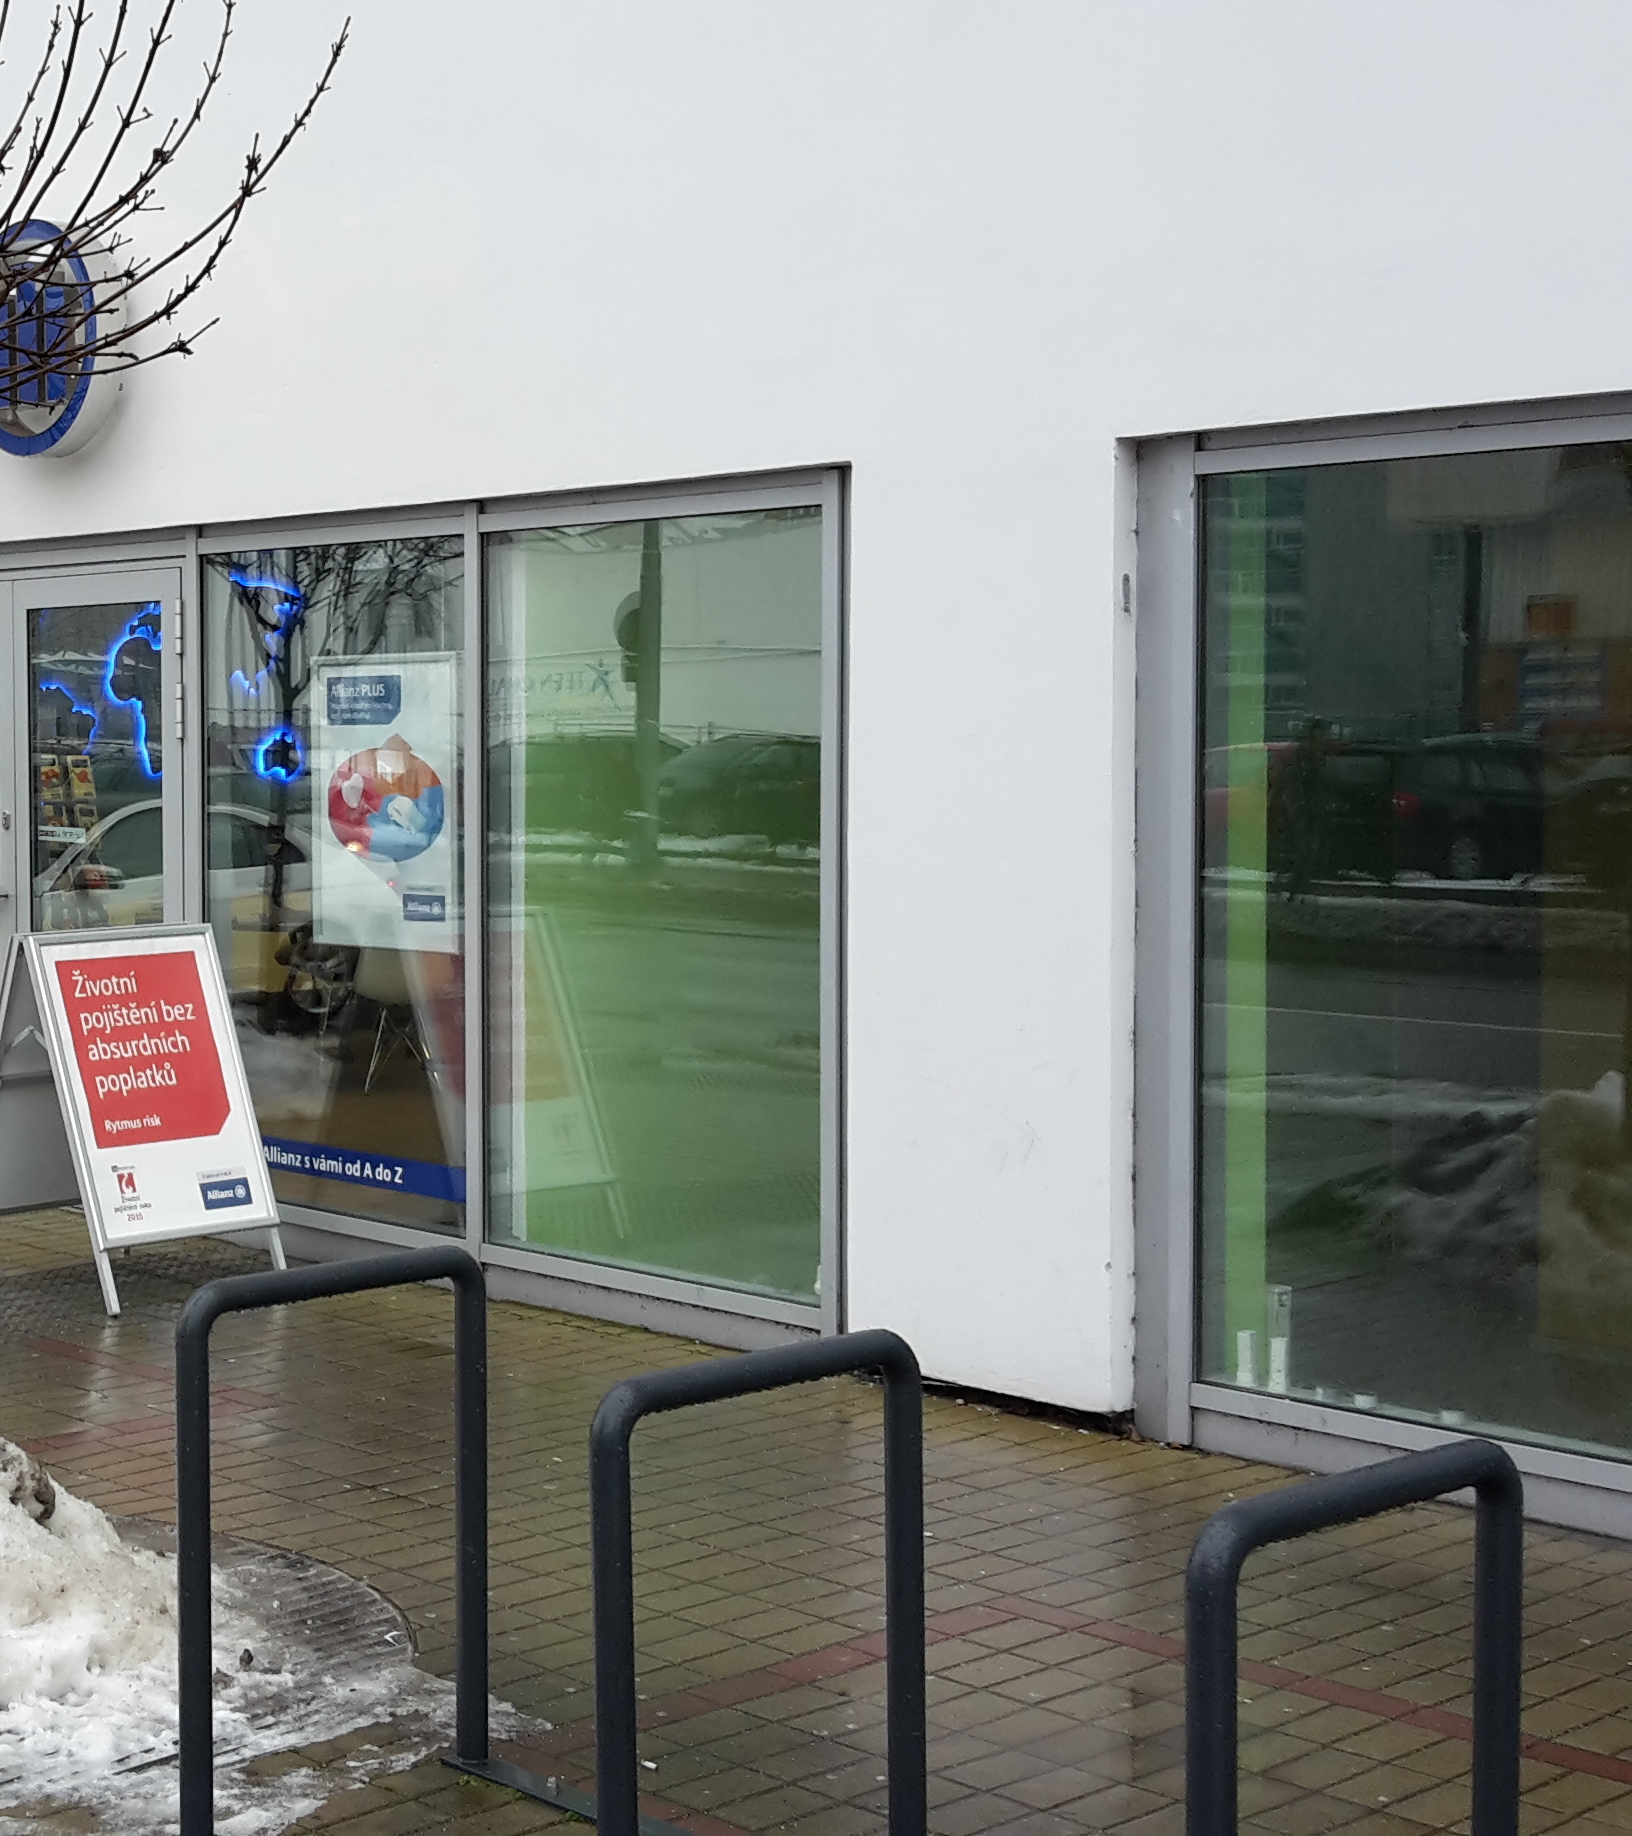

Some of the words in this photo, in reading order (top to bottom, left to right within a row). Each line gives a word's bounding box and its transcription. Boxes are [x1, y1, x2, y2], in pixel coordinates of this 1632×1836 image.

[361, 682, 386, 697] PLUS
[71, 969, 138, 998] Životní
[79, 1000, 159, 1036] pojištění
[160, 999, 196, 1022] bez
[87, 1029, 191, 1061] absurdních
[95, 1061, 177, 1099] poplatků
[104, 1119, 142, 1134] Rytmus
[143, 1114, 162, 1128] risk
[264, 1145, 302, 1167] Allianz
[312, 1154, 343, 1174] vámi
[345, 1159, 361, 1177] od
[363, 1162, 373, 1179] A
[375, 1163, 392, 1182] do
[393, 1166, 404, 1184] Z
